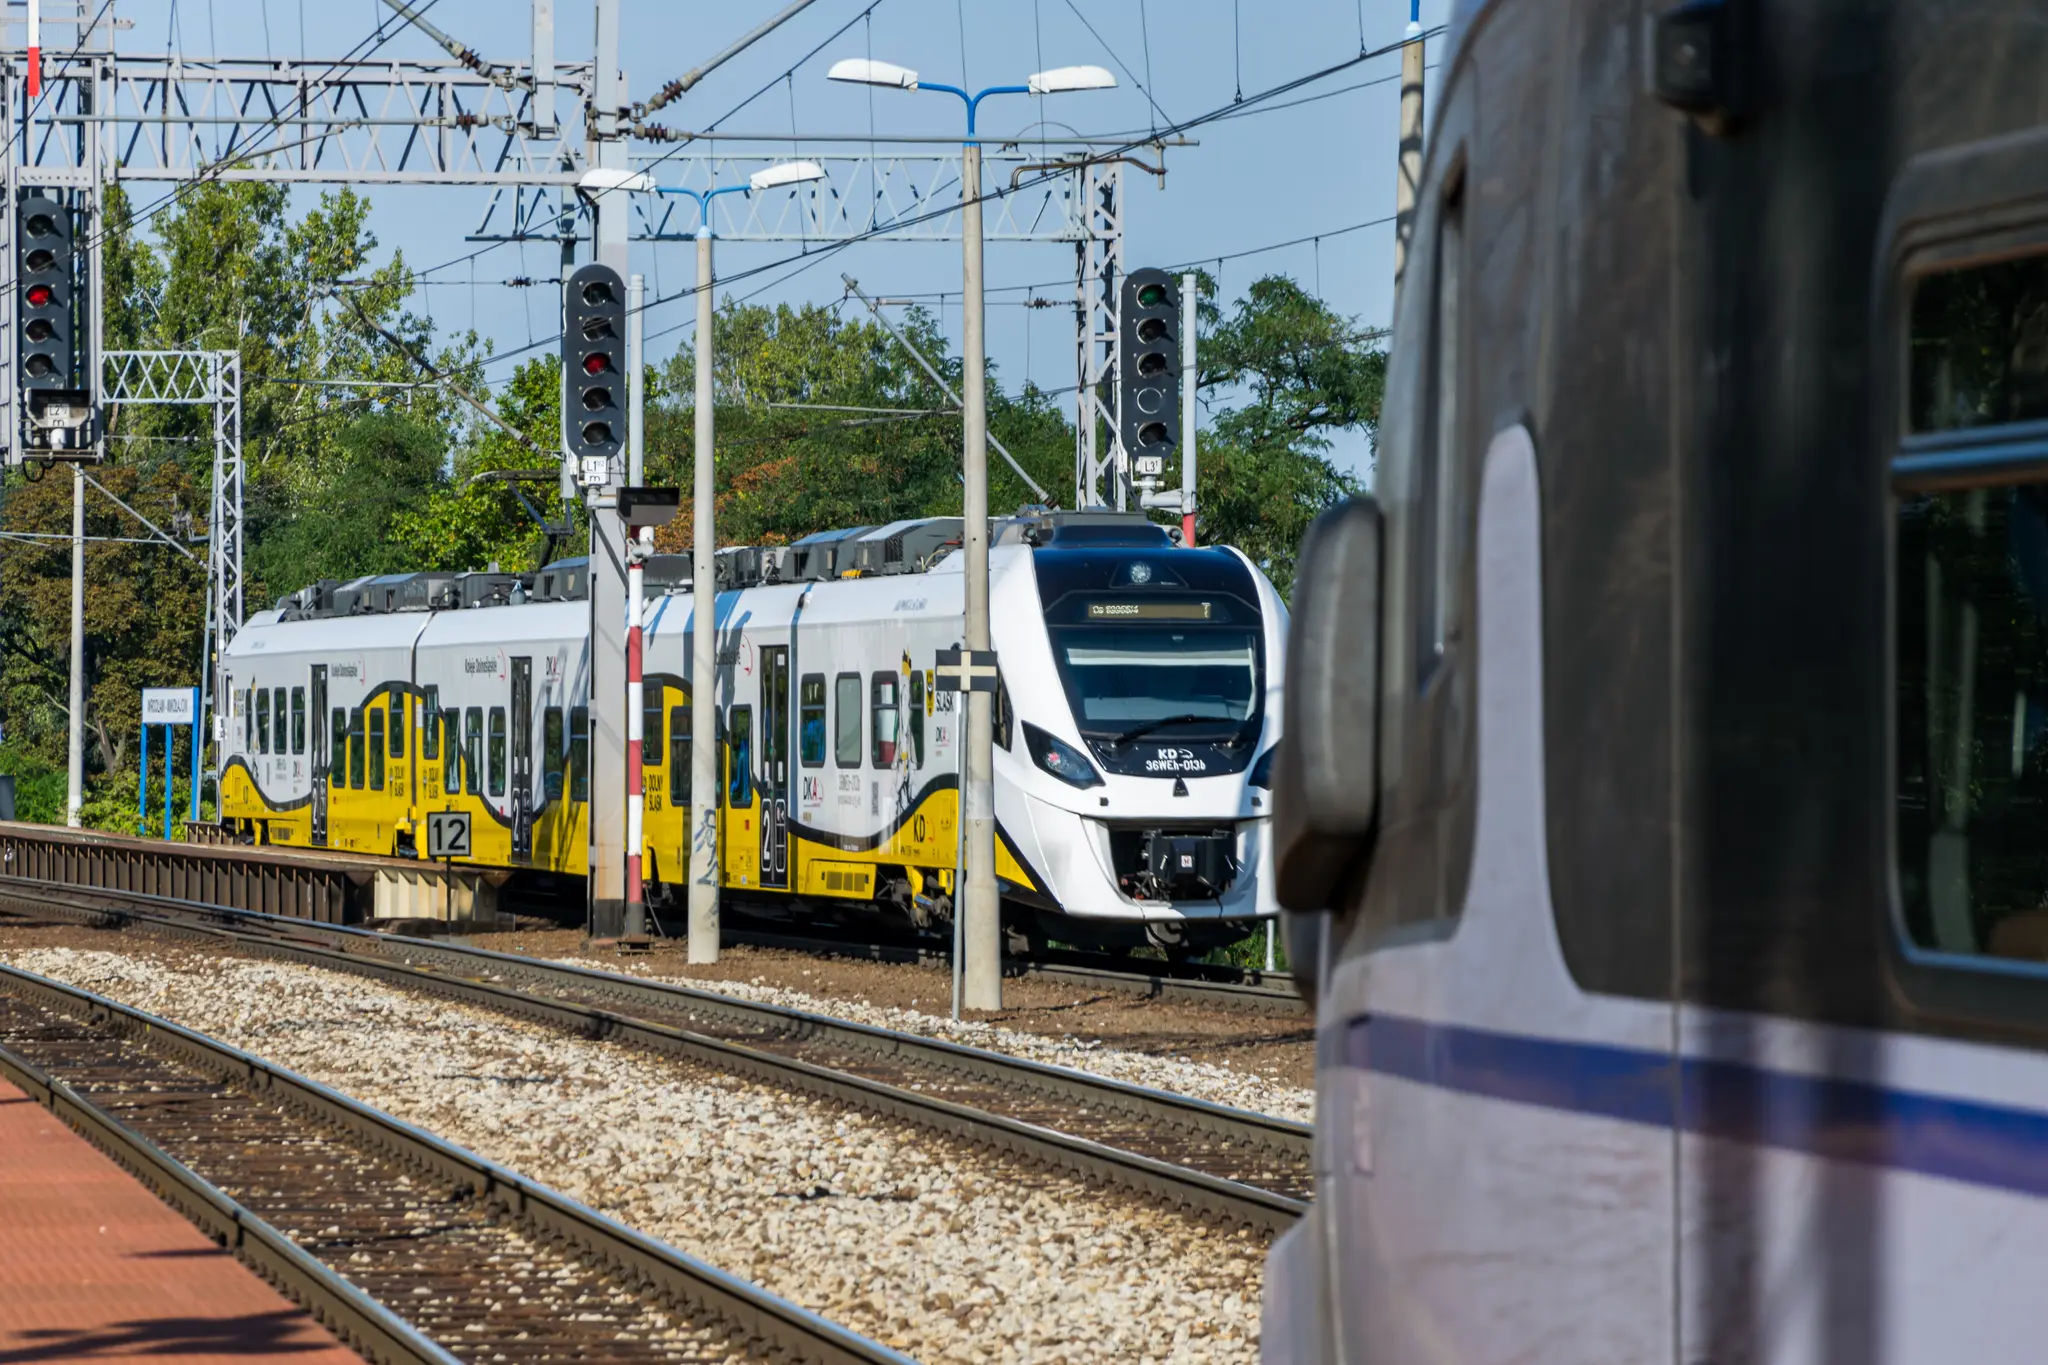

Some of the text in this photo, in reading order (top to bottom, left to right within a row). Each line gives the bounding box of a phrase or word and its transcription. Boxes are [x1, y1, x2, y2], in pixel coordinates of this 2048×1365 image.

[1158, 749, 1178, 759] KD
[433, 818, 466, 850] 12
[763, 809, 771, 860] 2
[913, 813, 925, 843] KD
